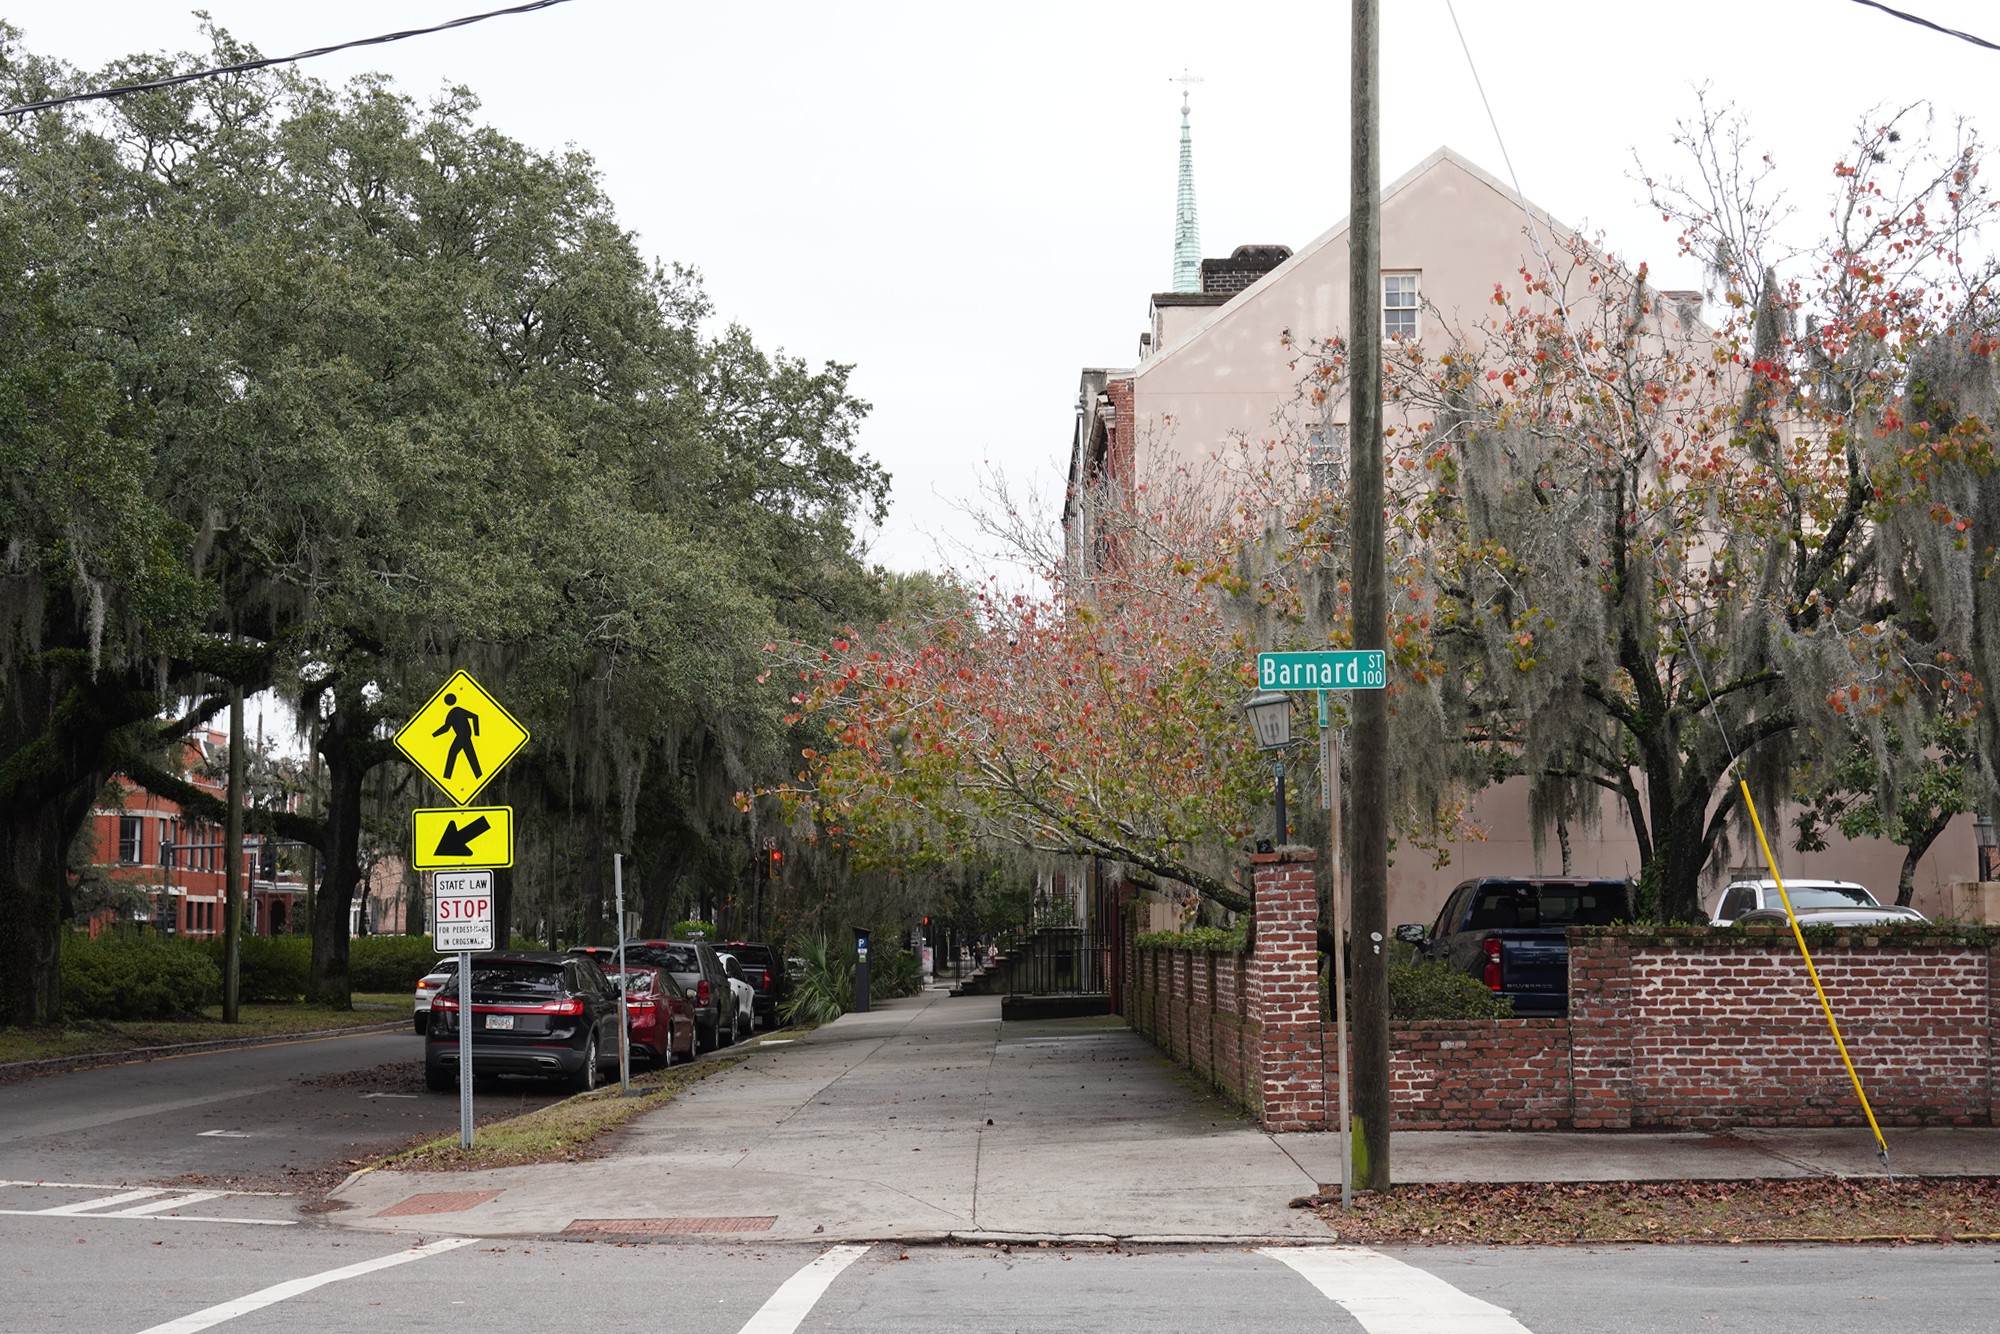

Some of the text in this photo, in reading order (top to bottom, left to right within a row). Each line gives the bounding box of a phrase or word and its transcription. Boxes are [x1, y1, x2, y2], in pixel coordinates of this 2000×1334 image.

[1263, 654, 1382, 685] Barnard ST
[1362, 671, 1382, 685] 100
[439, 879, 487, 891] STATE LAW
[440, 899, 488, 919] STOP
[439, 926, 450, 934] FOR
[443, 938, 450, 946] IN
[858, 938, 865, 947] P
